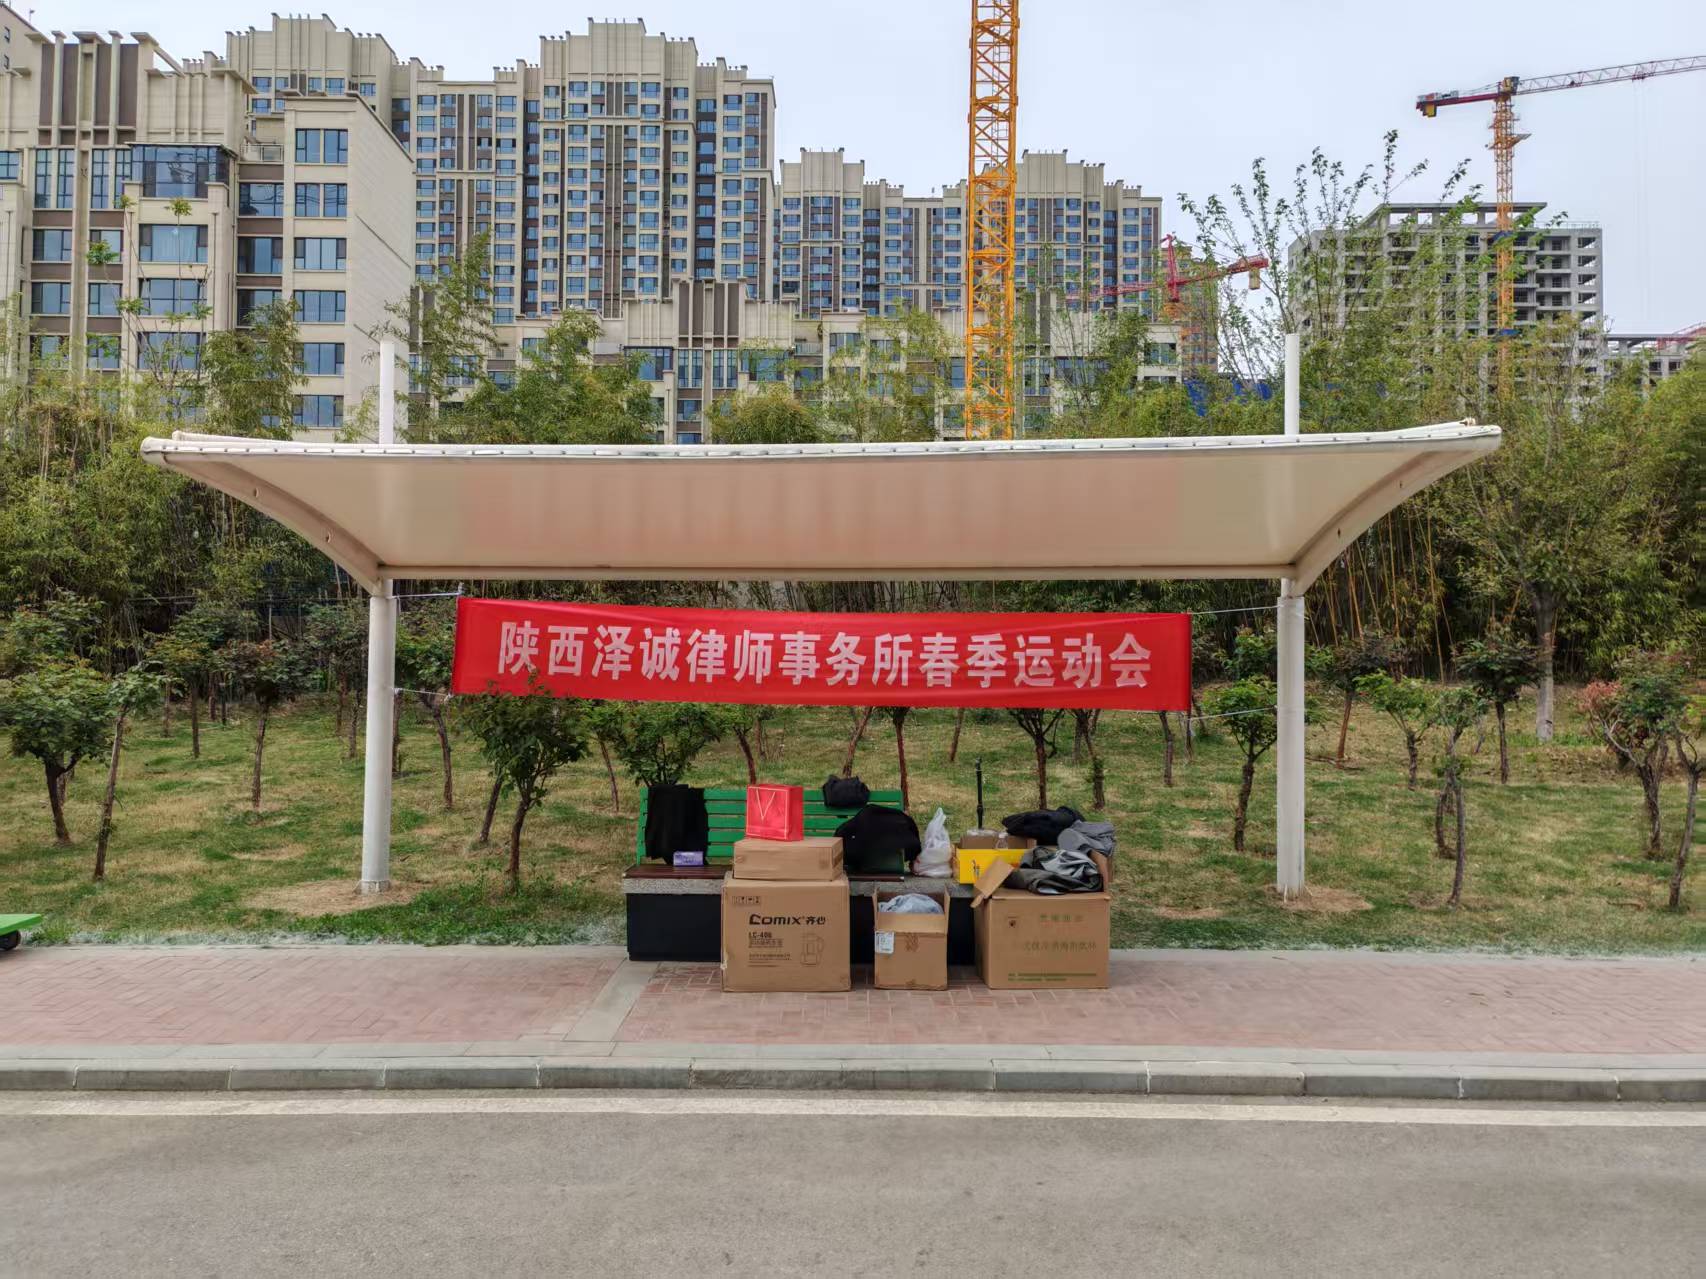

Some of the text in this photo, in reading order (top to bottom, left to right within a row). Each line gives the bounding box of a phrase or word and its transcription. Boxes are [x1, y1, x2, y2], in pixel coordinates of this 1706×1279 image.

[498, 620, 1151, 688] 陕西泽诚律师事务所春季运动会
